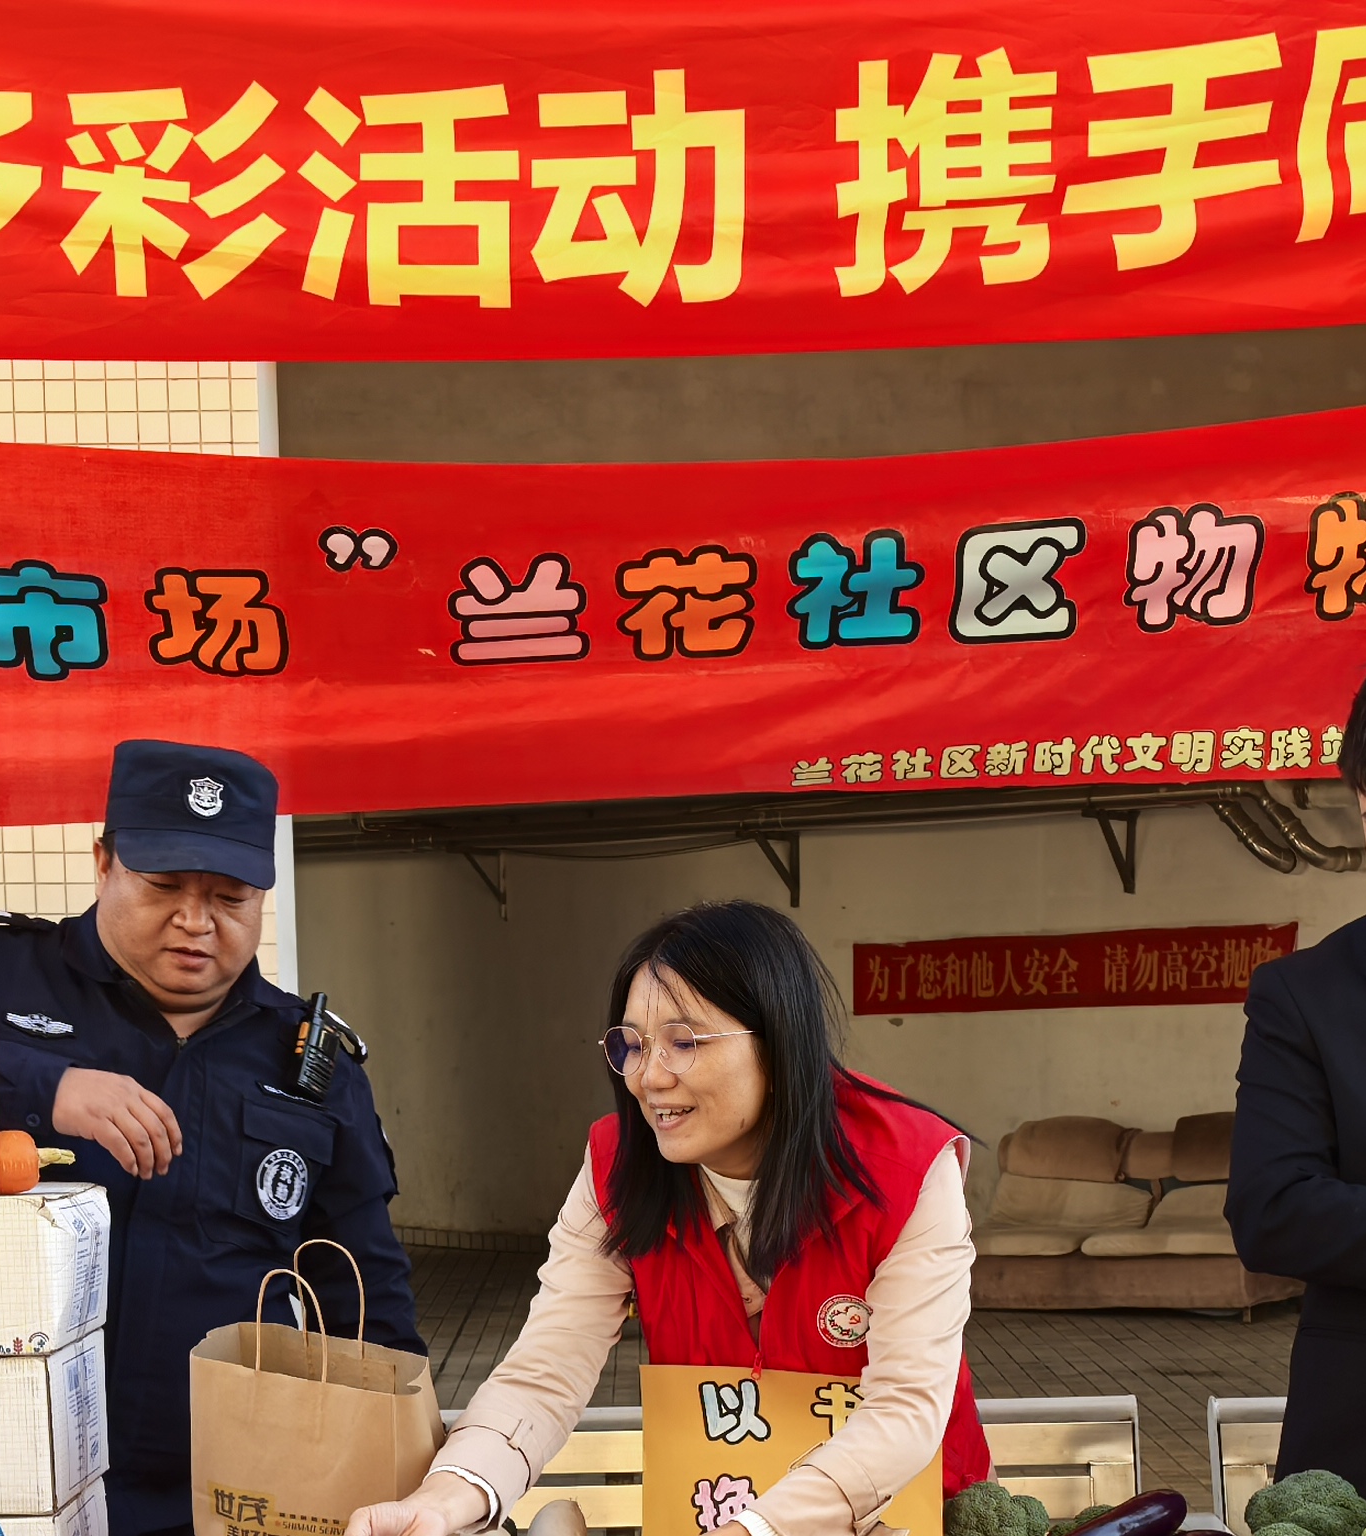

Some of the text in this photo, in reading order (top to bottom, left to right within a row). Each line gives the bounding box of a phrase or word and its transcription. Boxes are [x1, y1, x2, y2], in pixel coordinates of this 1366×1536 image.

[866, 946, 1080, 1002] 为了您和他人安全
[213, 1488, 269, 1527] 世茂
